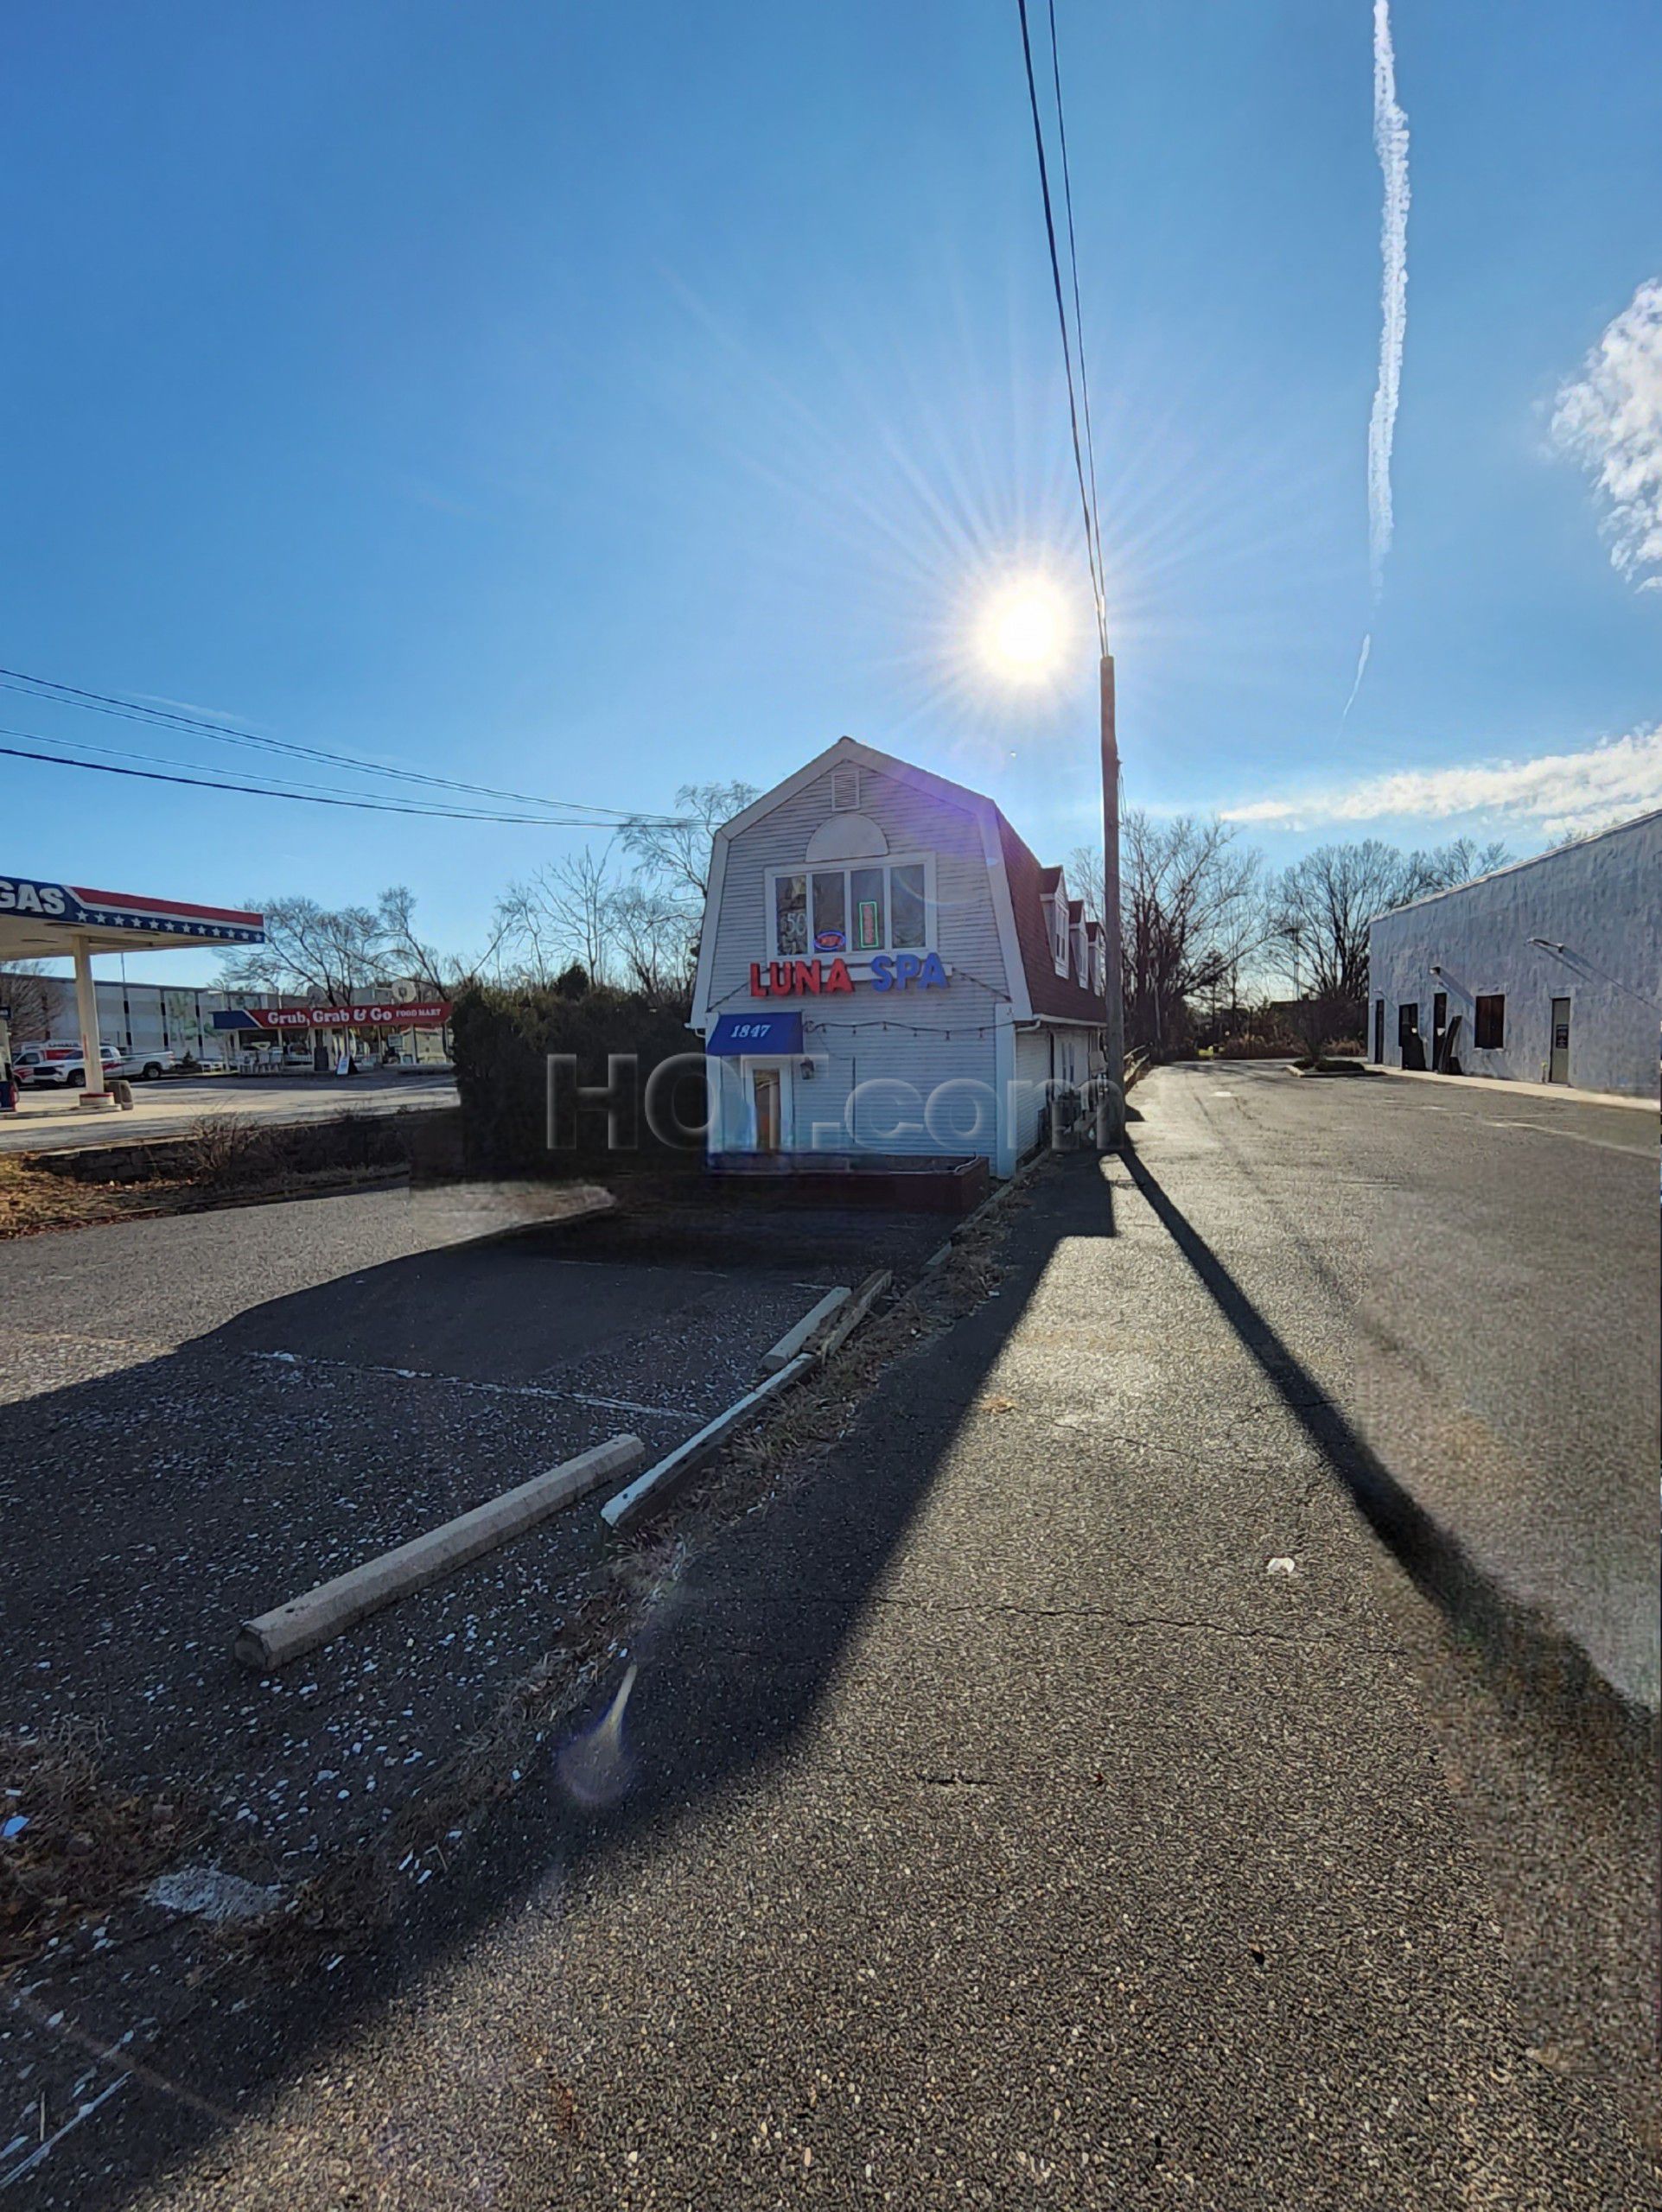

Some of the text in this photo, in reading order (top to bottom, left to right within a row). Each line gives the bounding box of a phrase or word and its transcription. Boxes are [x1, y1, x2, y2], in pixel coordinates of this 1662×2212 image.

[0, 880, 66, 914] GAS
[750, 952, 951, 997] LUNA SPA
[268, 1012, 309, 1027] Grub,
[313, 1009, 349, 1023] Grab
[353, 1009, 366, 1021] &
[370, 1007, 392, 1020] Go
[730, 1023, 773, 1039] 1847
